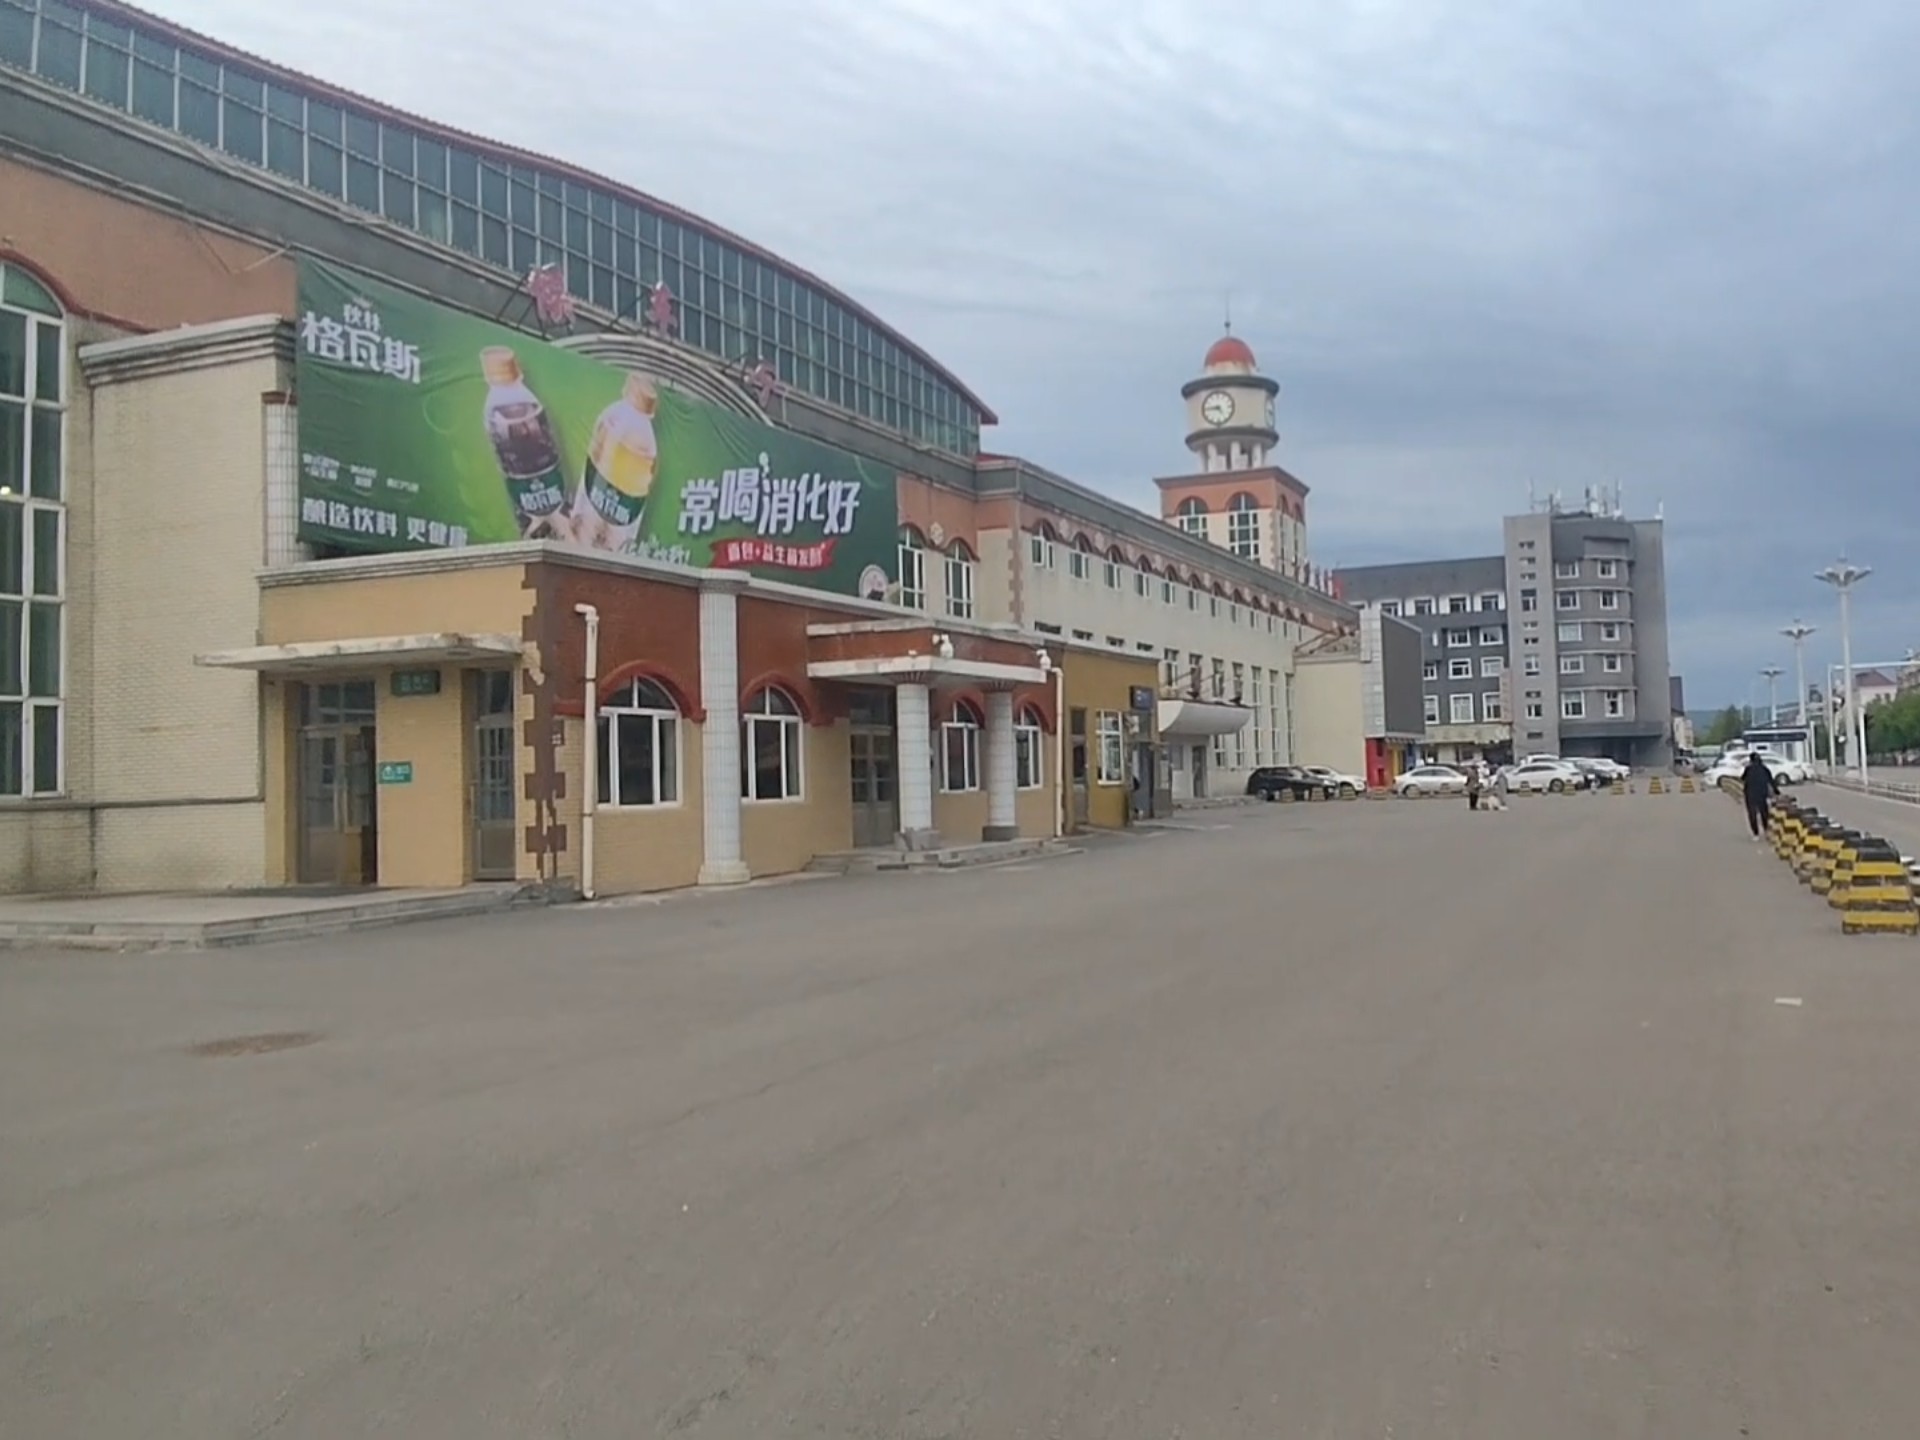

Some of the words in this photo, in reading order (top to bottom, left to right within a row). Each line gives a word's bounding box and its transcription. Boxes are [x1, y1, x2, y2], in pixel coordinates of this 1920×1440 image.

[301, 310, 421, 385] 格瓦斯
[302, 497, 398, 538] 酿造饮料
[678, 465, 861, 535] 常喝消化好
